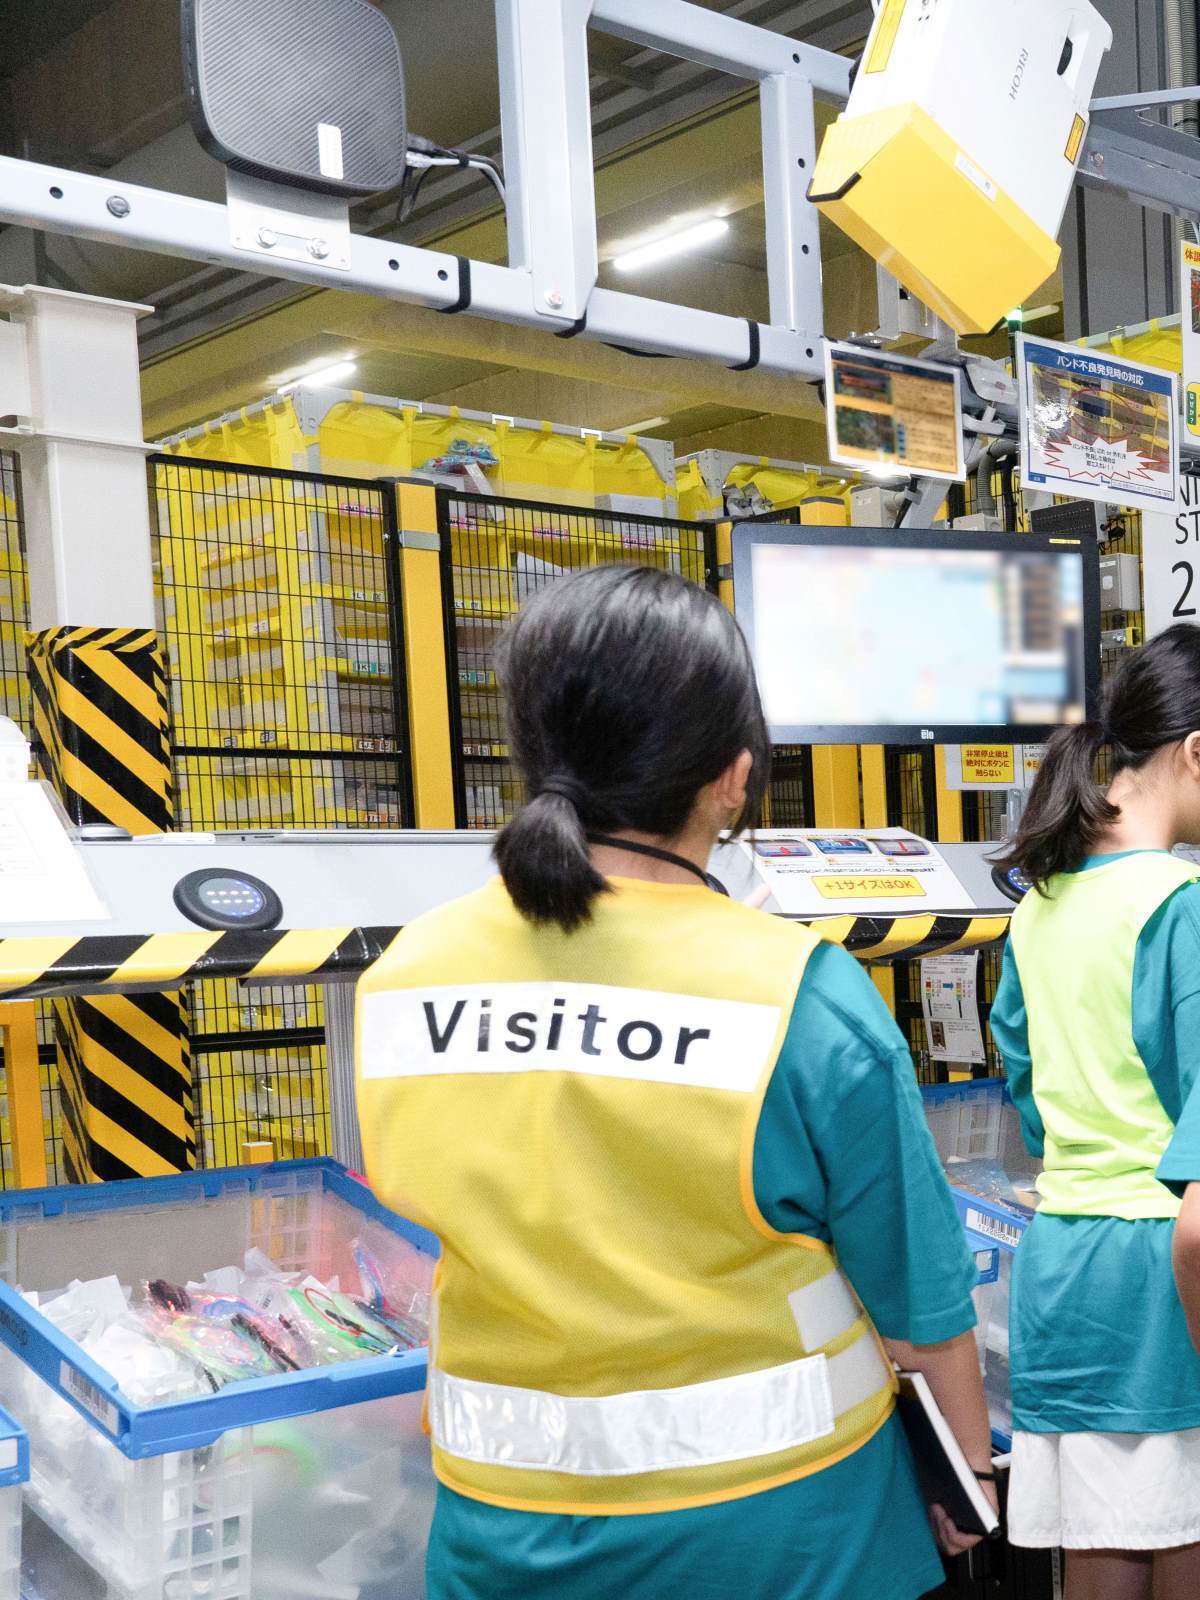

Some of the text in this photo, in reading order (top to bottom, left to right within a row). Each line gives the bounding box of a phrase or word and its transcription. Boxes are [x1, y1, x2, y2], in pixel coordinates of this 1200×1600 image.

[1008, 48, 1029, 100] RICOH
[1057, 355, 1144, 385] バンド不良発見時の対応
[966, 759, 1009, 767] 絶対にボタンに
[975, 769, 1001, 777] 触らない
[422, 998, 711, 1065] Visitor
